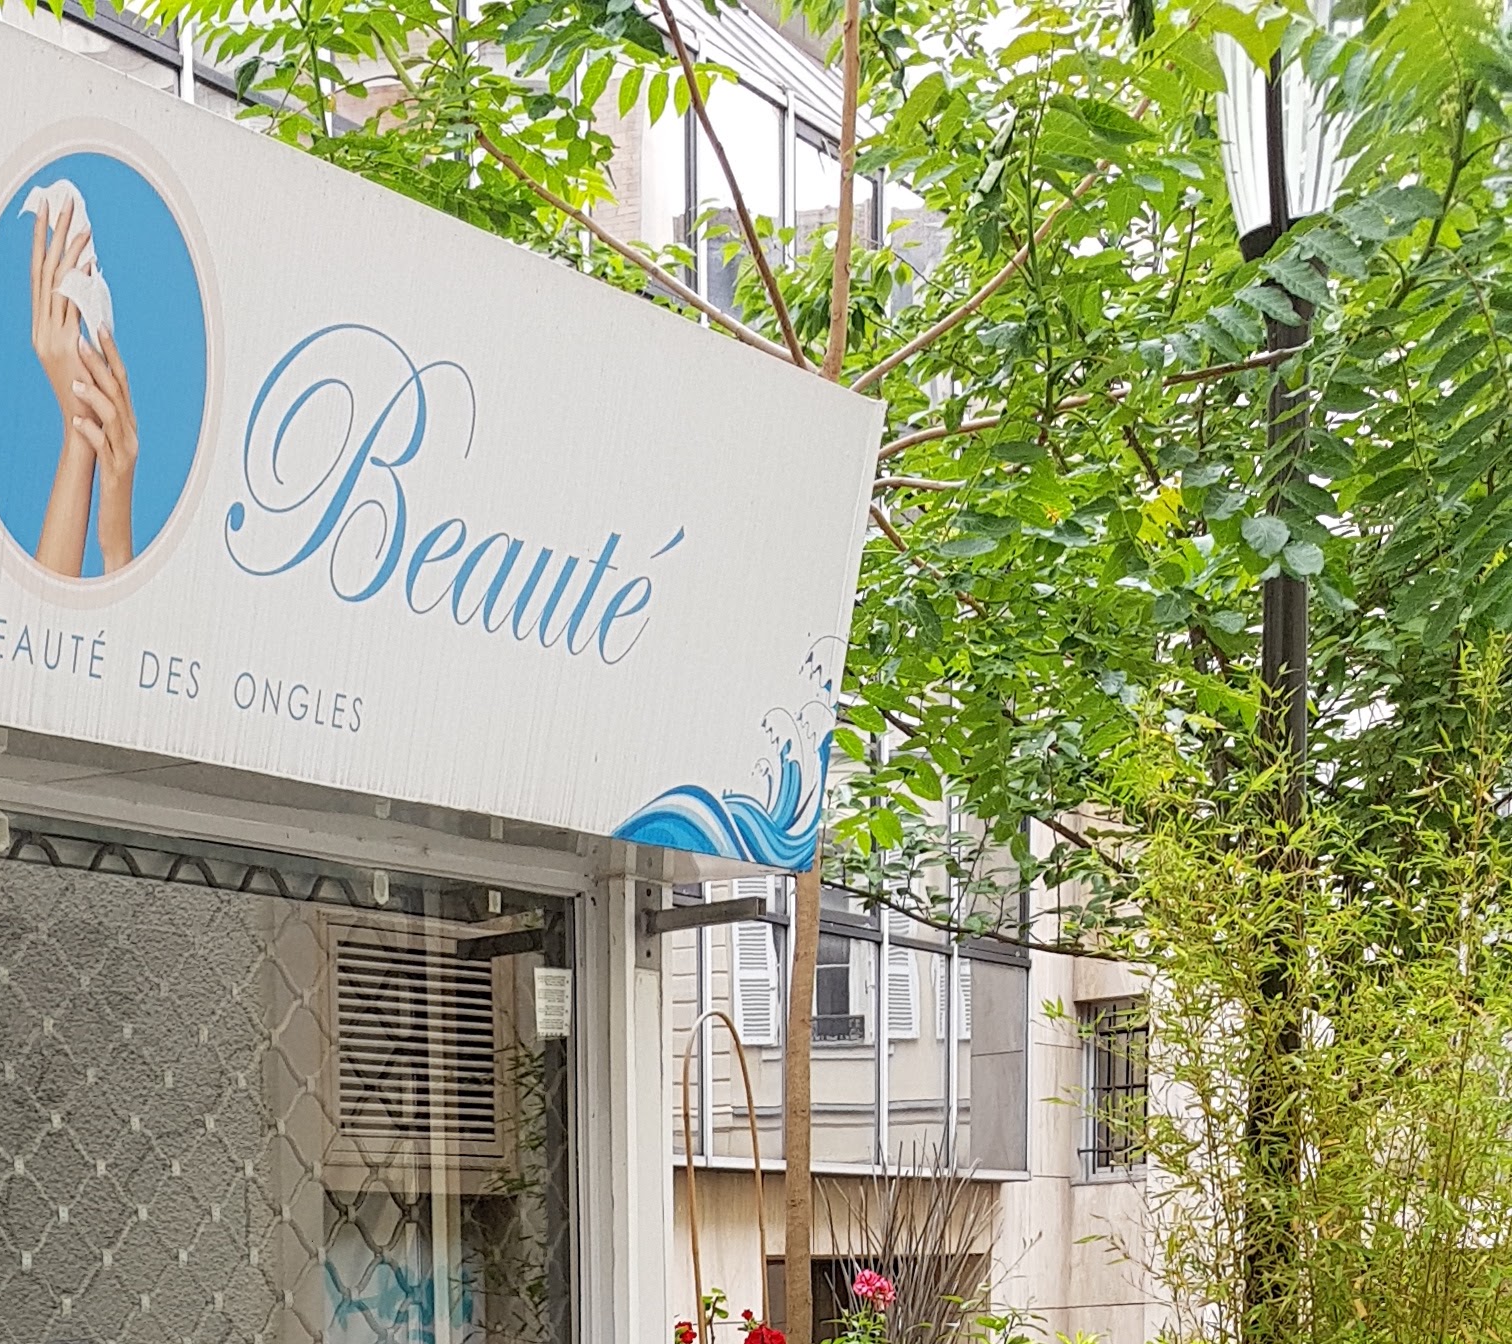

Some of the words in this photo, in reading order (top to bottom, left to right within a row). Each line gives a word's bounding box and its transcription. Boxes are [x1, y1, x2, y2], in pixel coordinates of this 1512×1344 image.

[225, 323, 686, 665] Beauté
[139, 650, 203, 700] DES
[233, 671, 364, 733] ONGLES
